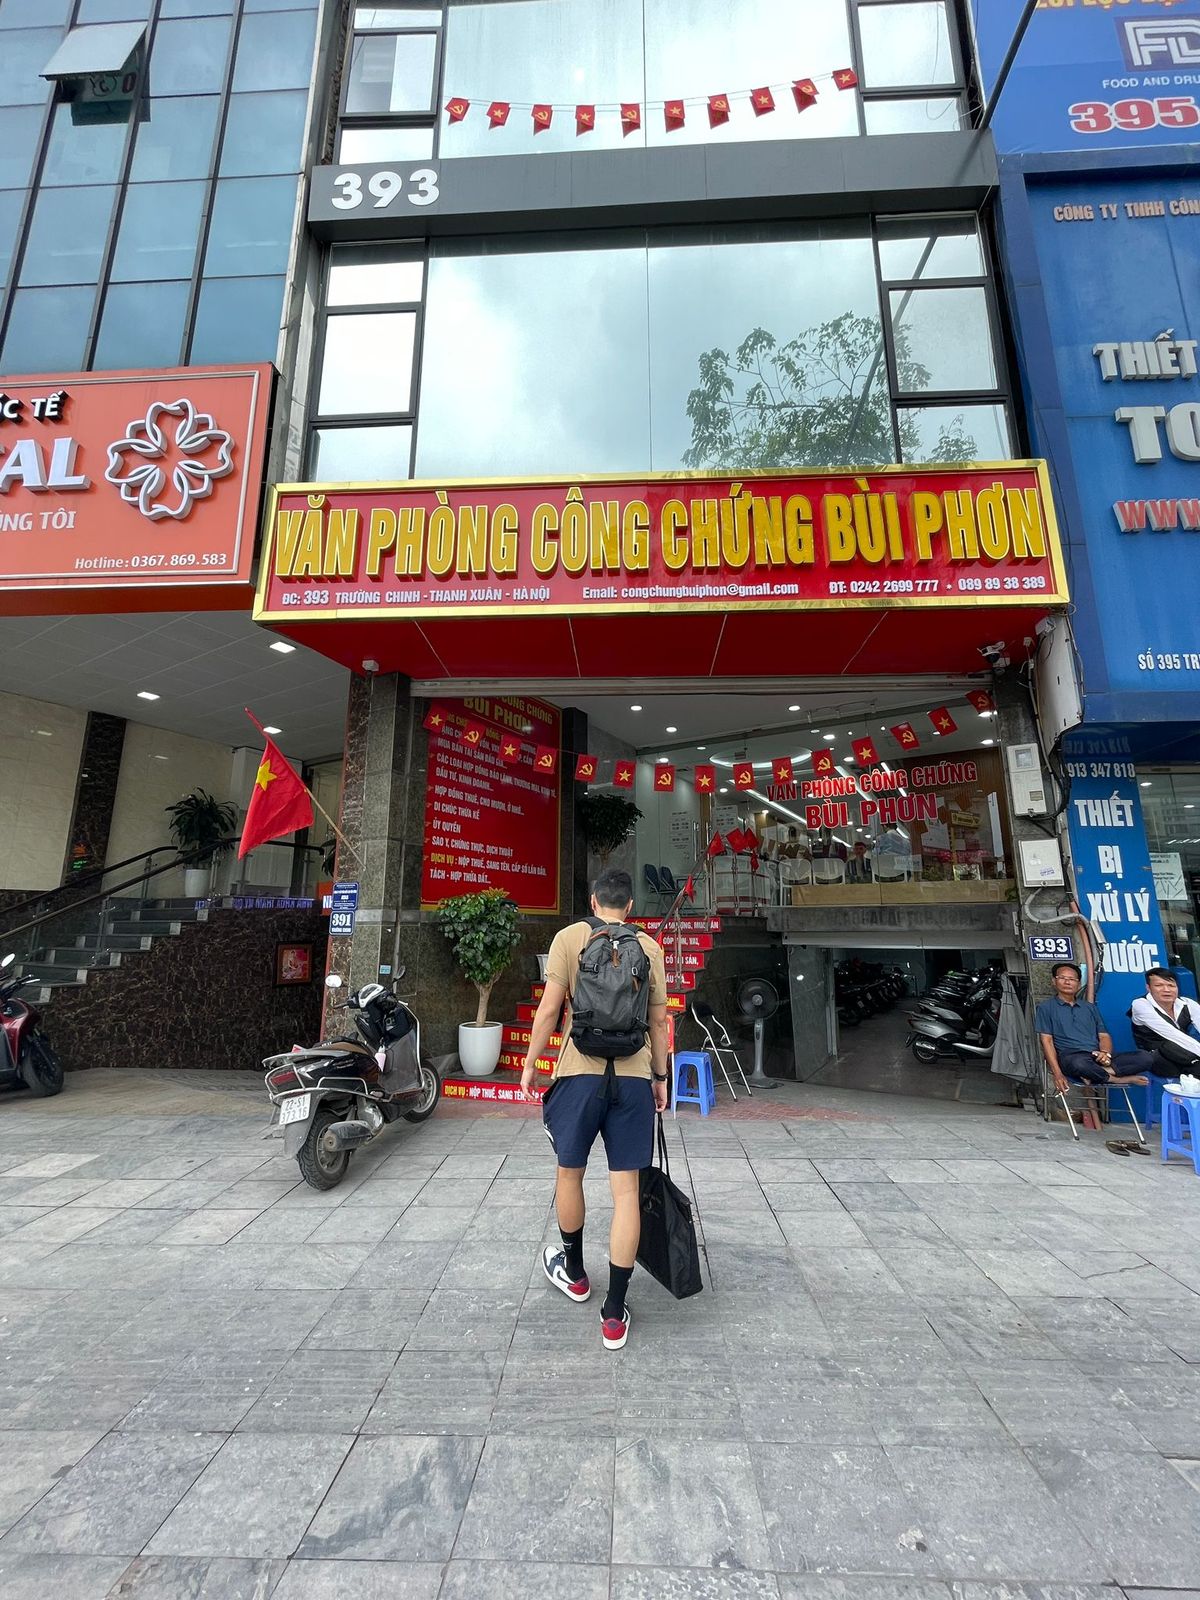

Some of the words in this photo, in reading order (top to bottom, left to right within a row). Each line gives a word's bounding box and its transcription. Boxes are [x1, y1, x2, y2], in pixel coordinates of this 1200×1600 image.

[1103, 76, 1138, 88] FOOD
[1143, 76, 1170, 87] AND
[1068, 96, 1200, 134] 395
[332, 168, 439, 210] 393
[1053, 202, 1094, 222] CÔNG
[1099, 203, 1118, 219] TY
[1124, 201, 1165, 218] TNHH
[1093, 328, 1198, 381] THIẾT
[31, 390, 64, 417] TẾ
[40, 508, 76, 530] TÔI
[275, 494, 359, 576] VĂN
[366, 490, 519, 576] PHÒNG
[530, 486, 650, 573] CÔNG
[660, 483, 815, 570] CHỨNG
[823, 477, 905, 564] BÙI
[911, 481, 1047, 561] PHƠN
[131, 553, 227, 568] 0367.869.583
[282, 593, 301, 605] ĐC:
[303, 589, 329, 605] 393
[335, 588, 381, 604] TRƯỜNG
[385, 590, 420, 604] CHINH
[430, 589, 467, 603] THANH
[470, 585, 502, 602] XUÂN
[513, 585, 529, 601] HÀ
[530, 587, 550, 603] NỘI
[582, 587, 618, 599] Email:
[621, 582, 799, 599] congchungbuiphon@gmail.com
[829, 581, 847, 594] ĐT:
[850, 580, 881, 594] 0242
[883, 579, 914, 593] 2699
[915, 579, 939, 592] 777
[957, 578, 982, 591] 089
[984, 577, 1001, 590] 89
[1003, 576, 1019, 590] 38
[1022, 576, 1046, 589] 389
[1138, 647, 1155, 670] SỐ
[1157, 654, 1181, 670] 395
[801, 775, 856, 800] PHÒNG
[860, 769, 908, 793] CÔNG
[912, 761, 978, 786] CHỨNG
[1091, 763, 1111, 778] 347
[805, 799, 848, 830] BÙI
[860, 793, 939, 826] PHƠN
[1074, 790, 1134, 827] THIẾT
[1097, 845, 1124, 879] BỊ
[1086, 882, 1122, 922] XỬ
[1124, 888, 1150, 922] LÝ
[332, 913, 352, 927] 391
[1033, 938, 1068, 953] 393
[510, 1032, 520, 1041] DI
[500, 1055, 511, 1064] AO
[498, 1090, 514, 1100] SANG
